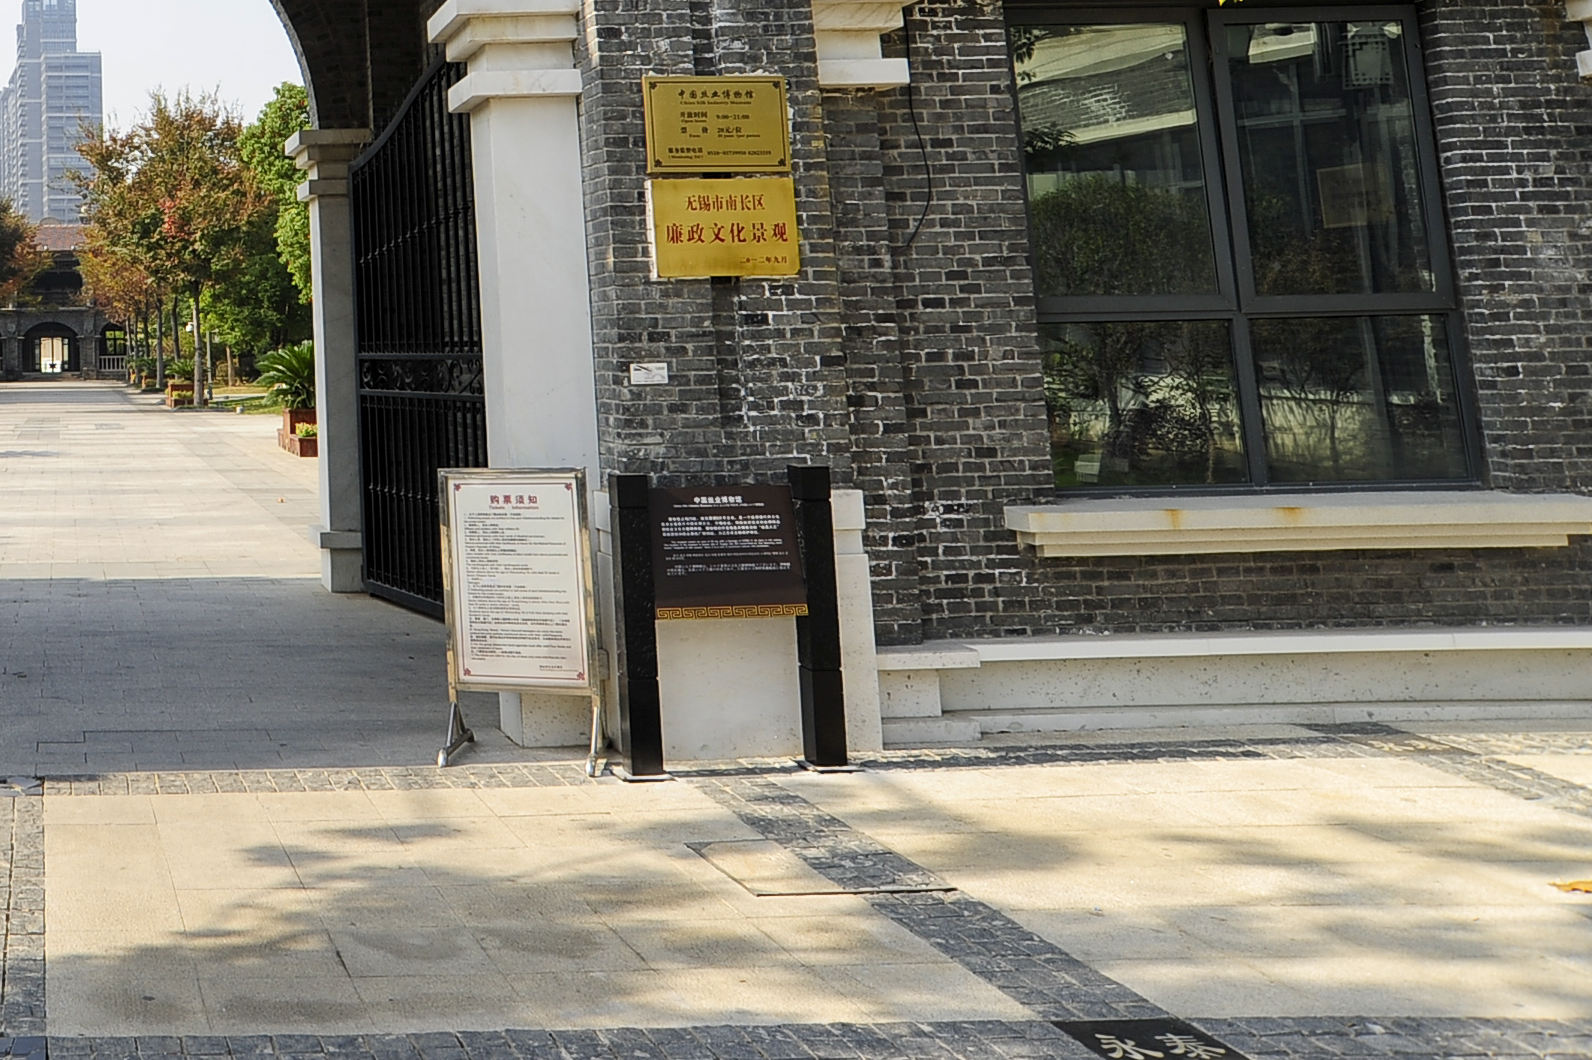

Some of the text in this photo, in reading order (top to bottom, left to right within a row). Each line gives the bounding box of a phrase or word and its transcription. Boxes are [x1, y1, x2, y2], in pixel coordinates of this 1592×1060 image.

[685, 194, 766, 212] 无锡市南长区
[666, 222, 789, 244] 廉政文化景观
[489, 494, 538, 505] 购票须知
